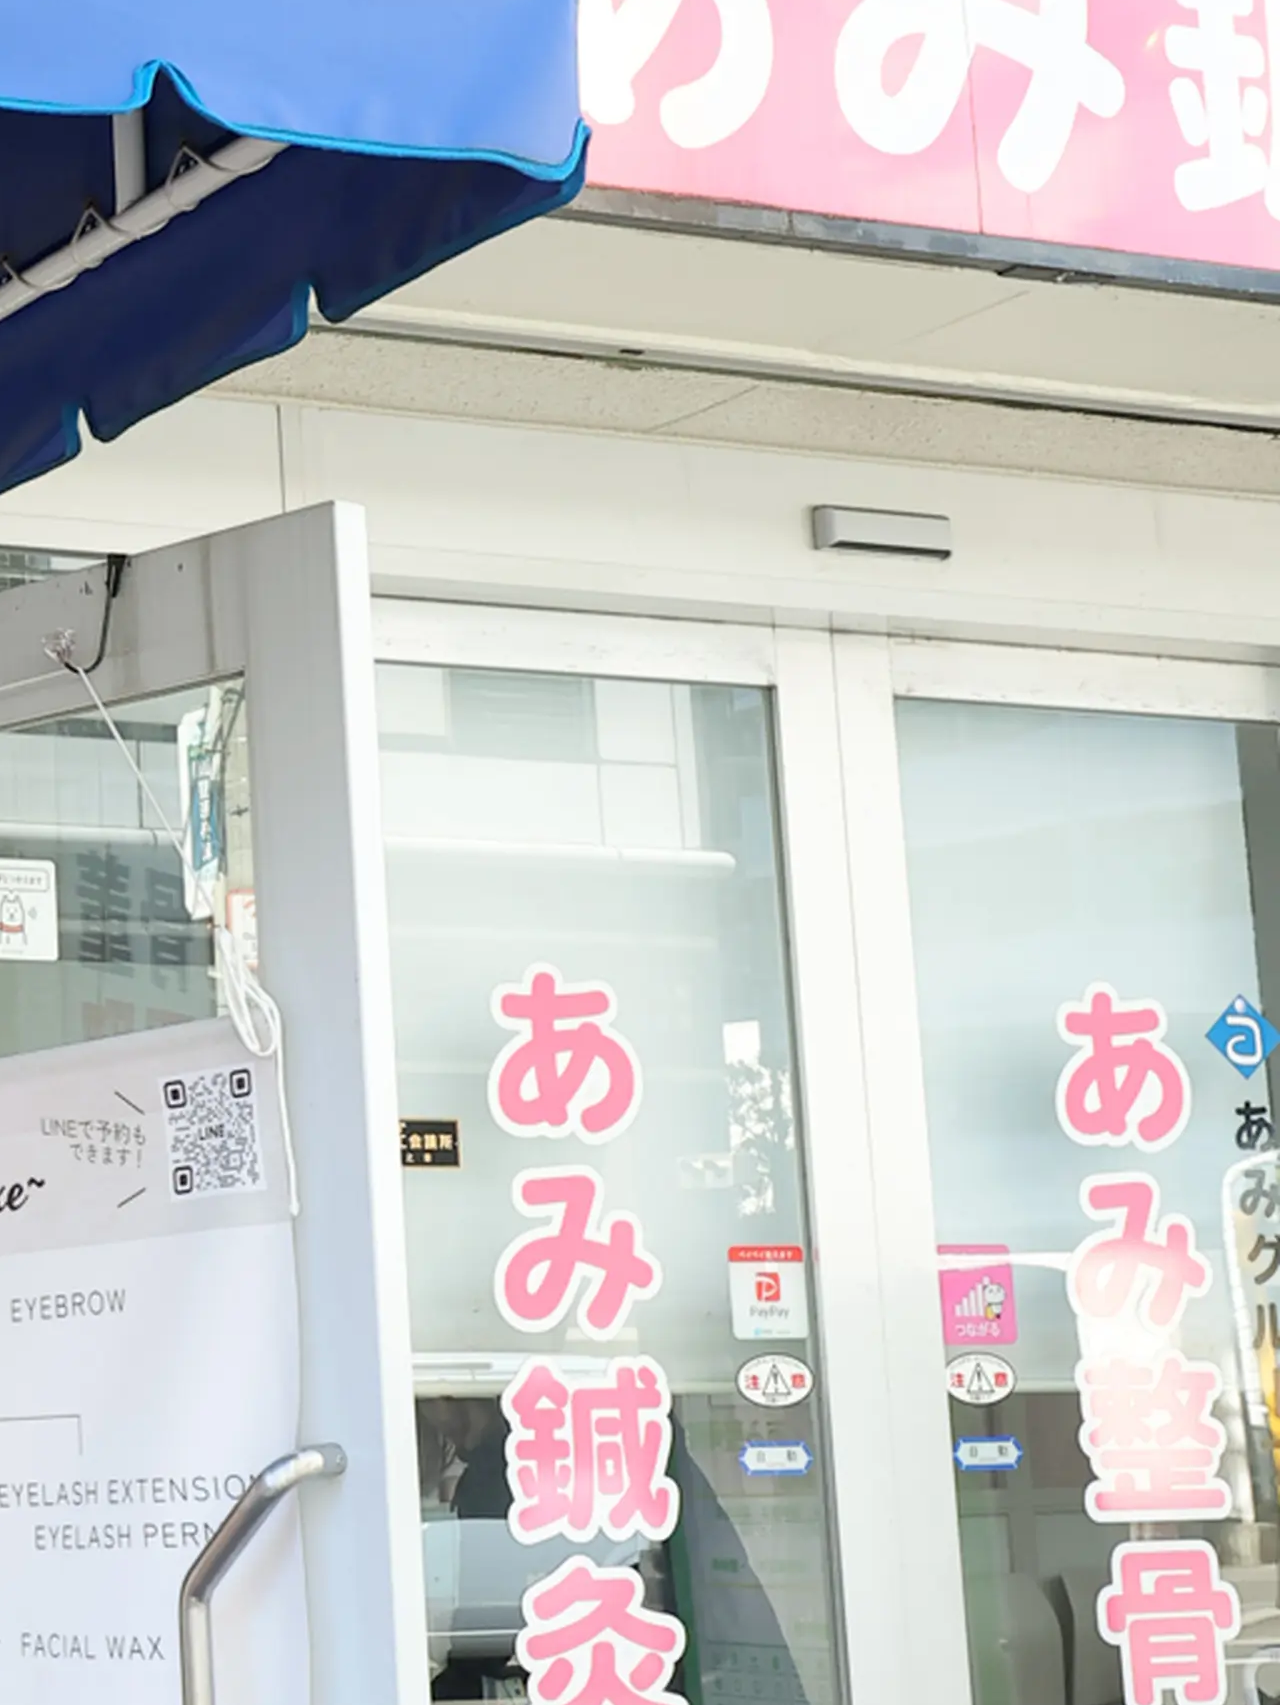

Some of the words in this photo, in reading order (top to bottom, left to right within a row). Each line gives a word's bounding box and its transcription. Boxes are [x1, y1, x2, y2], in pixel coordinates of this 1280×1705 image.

[40, 1117, 146, 1145] LINEで予約も
[11, 1288, 126, 1323] EYEBROW
[34, 1524, 132, 1550] EYELASH
[20, 1632, 96, 1660] FACIAL
[106, 1635, 166, 1661] WAX
